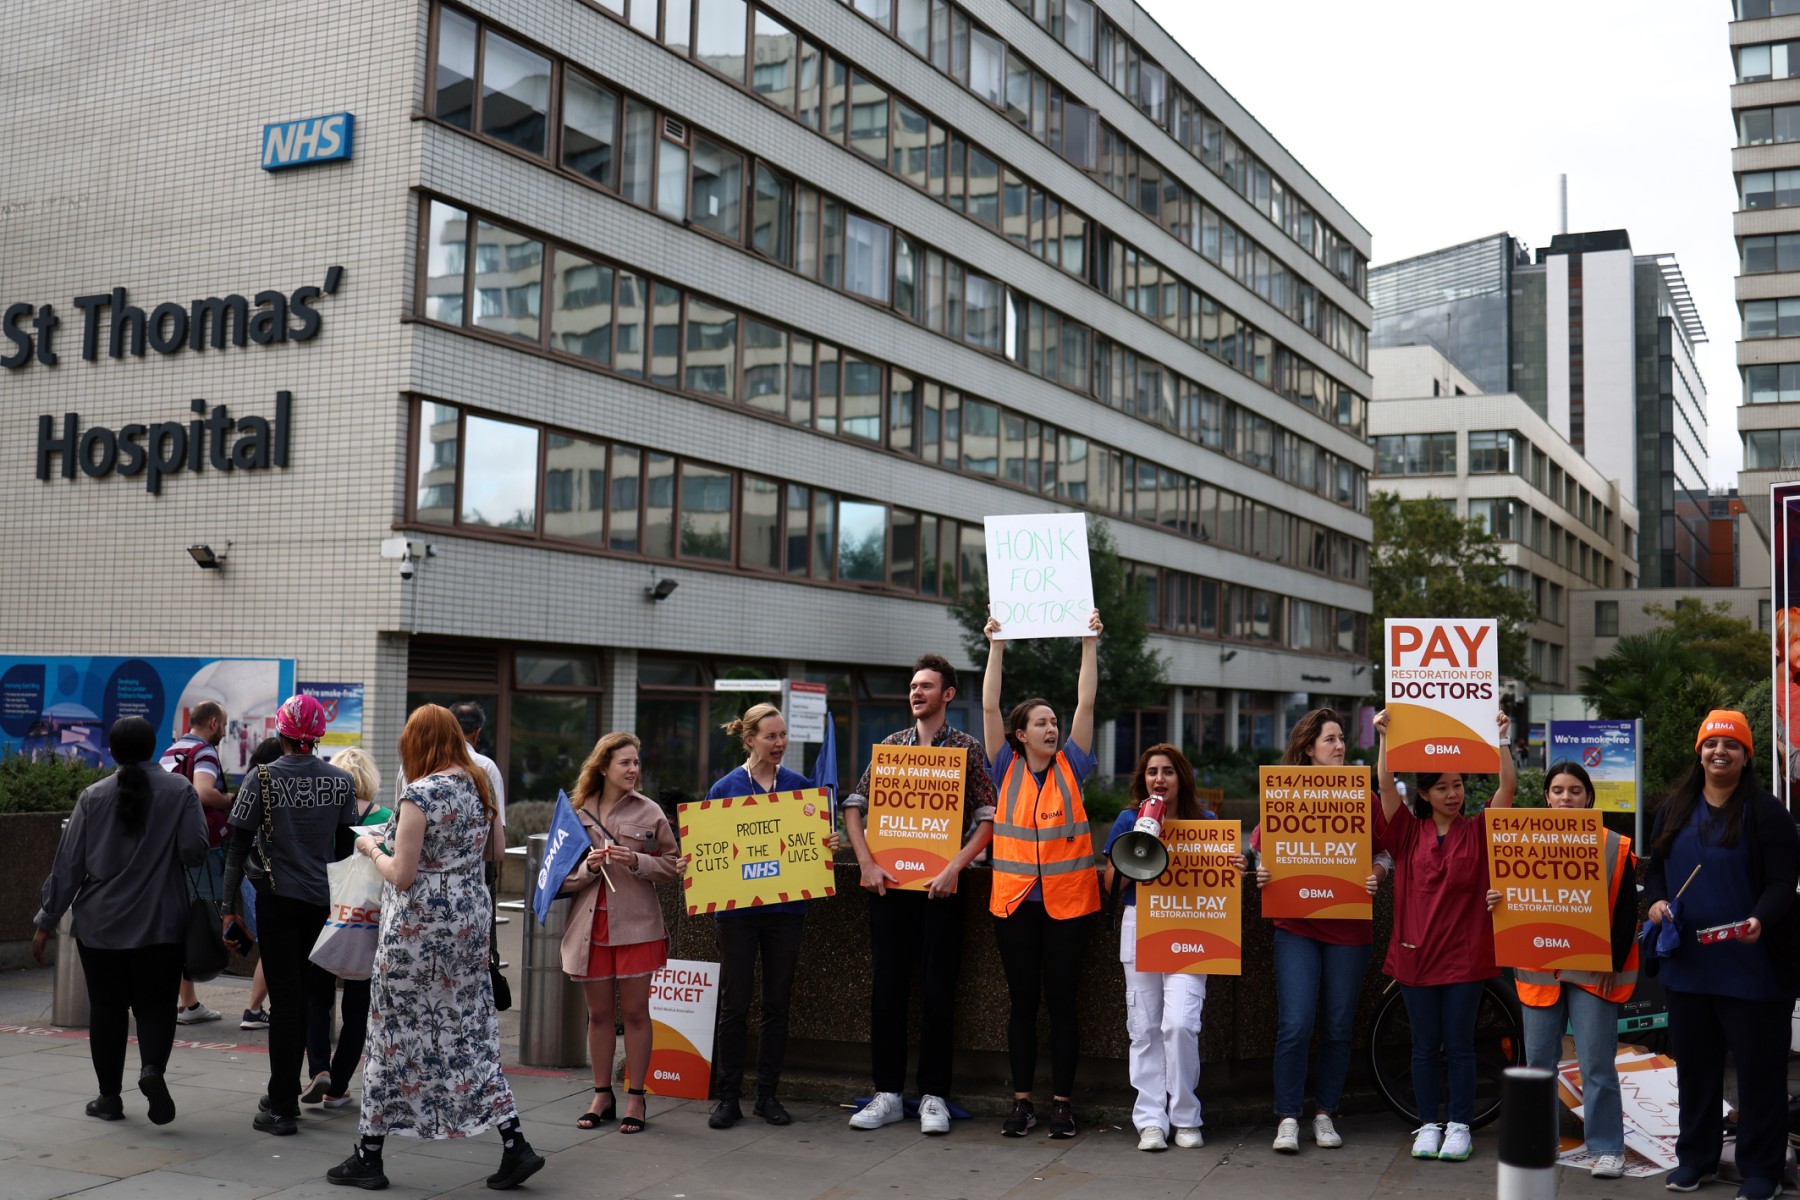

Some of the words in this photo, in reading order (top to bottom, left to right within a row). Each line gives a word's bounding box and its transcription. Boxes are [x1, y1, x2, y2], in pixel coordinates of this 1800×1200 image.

[264, 115, 344, 166] NHS
[0, 301, 58, 369] St
[74, 265, 343, 362] Thomas'
[36, 391, 291, 495] Hospital
[995, 528, 1080, 561] HONK
[1010, 565, 1063, 593] FOR
[994, 598, 1089, 625] DOCTORS
[1391, 625, 1491, 668] PAY
[1391, 669, 1467, 680] RESTORATION
[1470, 670, 1492, 680] FOR
[1391, 681, 1493, 700] DOCTORS
[1714, 722, 1735, 731] BMA
[1554, 735, 1579, 744] We're
[1580, 735, 1630, 744] smoke-free
[1436, 744, 1461, 755] BMA
[876, 753, 947, 767] £14/HOUR
[949, 756, 961, 768] IS
[875, 766, 897, 776] NOT
[898, 767, 906, 776] A
[907, 767, 930, 778] FAIR
[931, 769, 961, 779] WAGE
[874, 777, 900, 789] FOR
[902, 778, 911, 790] A
[913, 779, 960, 792] JUNIOR
[1265, 774, 1347, 788] £14/HOUR
[1351, 775, 1365, 788] IS
[873, 790, 959, 812] DOCTOR
[1265, 789, 1290, 799] NOT
[1292, 789, 1301, 799] A
[1303, 789, 1329, 800] FAIR
[1331, 789, 1366, 800] WAGE
[1048, 810, 1063, 819] BMA
[1265, 801, 1295, 813] FOR
[1298, 801, 1309, 813] A
[1311, 801, 1366, 815] JUNIOR
[736, 819, 781, 837] PROTECT
[879, 815, 918, 831] FULL
[921, 817, 950, 832] PAY
[1266, 815, 1366, 834] DOCTOR
[1492, 817, 1578, 832] £14/HOUR
[1582, 818, 1597, 832] IS
[879, 830, 929, 839] RESTORATION
[1159, 828, 1218, 841] 4/HOUR
[1222, 829, 1235, 841] IS
[1492, 833, 1518, 843] NOT
[1520, 833, 1530, 843] A
[1532, 833, 1559, 844] FAIR
[1561, 834, 1598, 845] WAGE
[695, 841, 729, 857] STOP
[746, 844, 769, 857] THE
[788, 832, 816, 847] SAVE
[1166, 843, 1174, 853] A
[1176, 843, 1202, 853] FAIR
[1203, 843, 1235, 853] WAGE
[1275, 841, 1321, 856] FULL
[1325, 842, 1357, 857] PAY
[696, 857, 729, 872] CUTS
[787, 848, 819, 863] LIVES
[1493, 845, 1524, 858] FOR
[1528, 846, 1539, 858] A
[1542, 846, 1599, 860] JUNIOR
[904, 861, 926, 872] BMA
[1172, 855, 1182, 867] A
[1184, 855, 1235, 868] JUNIOR
[1276, 857, 1335, 865] RESTORATION
[1336, 857, 1357, 865] NOW
[743, 860, 778, 880] NHS
[1494, 859, 1600, 881] DOCTOR
[1142, 869, 1236, 888] OCTOR
[1310, 888, 1335, 898] BMA
[1506, 887, 1554, 903] FULL
[1558, 889, 1592, 905] PAY
[1150, 895, 1193, 910] FULL
[1196, 896, 1228, 911] PAY
[1507, 903, 1569, 913] RESTORATION
[1571, 905, 1593, 914] NOW
[328, 903, 380, 924] ESC
[1150, 910, 1206, 918] RESTORATION
[1207, 911, 1227, 919] NOW
[1181, 943, 1205, 953] BMA
[1545, 937, 1571, 949] BMA
[653, 968, 713, 987] FFICIAL
[648, 985, 704, 1003] PICKET
[662, 1071, 681, 1081] BMA
